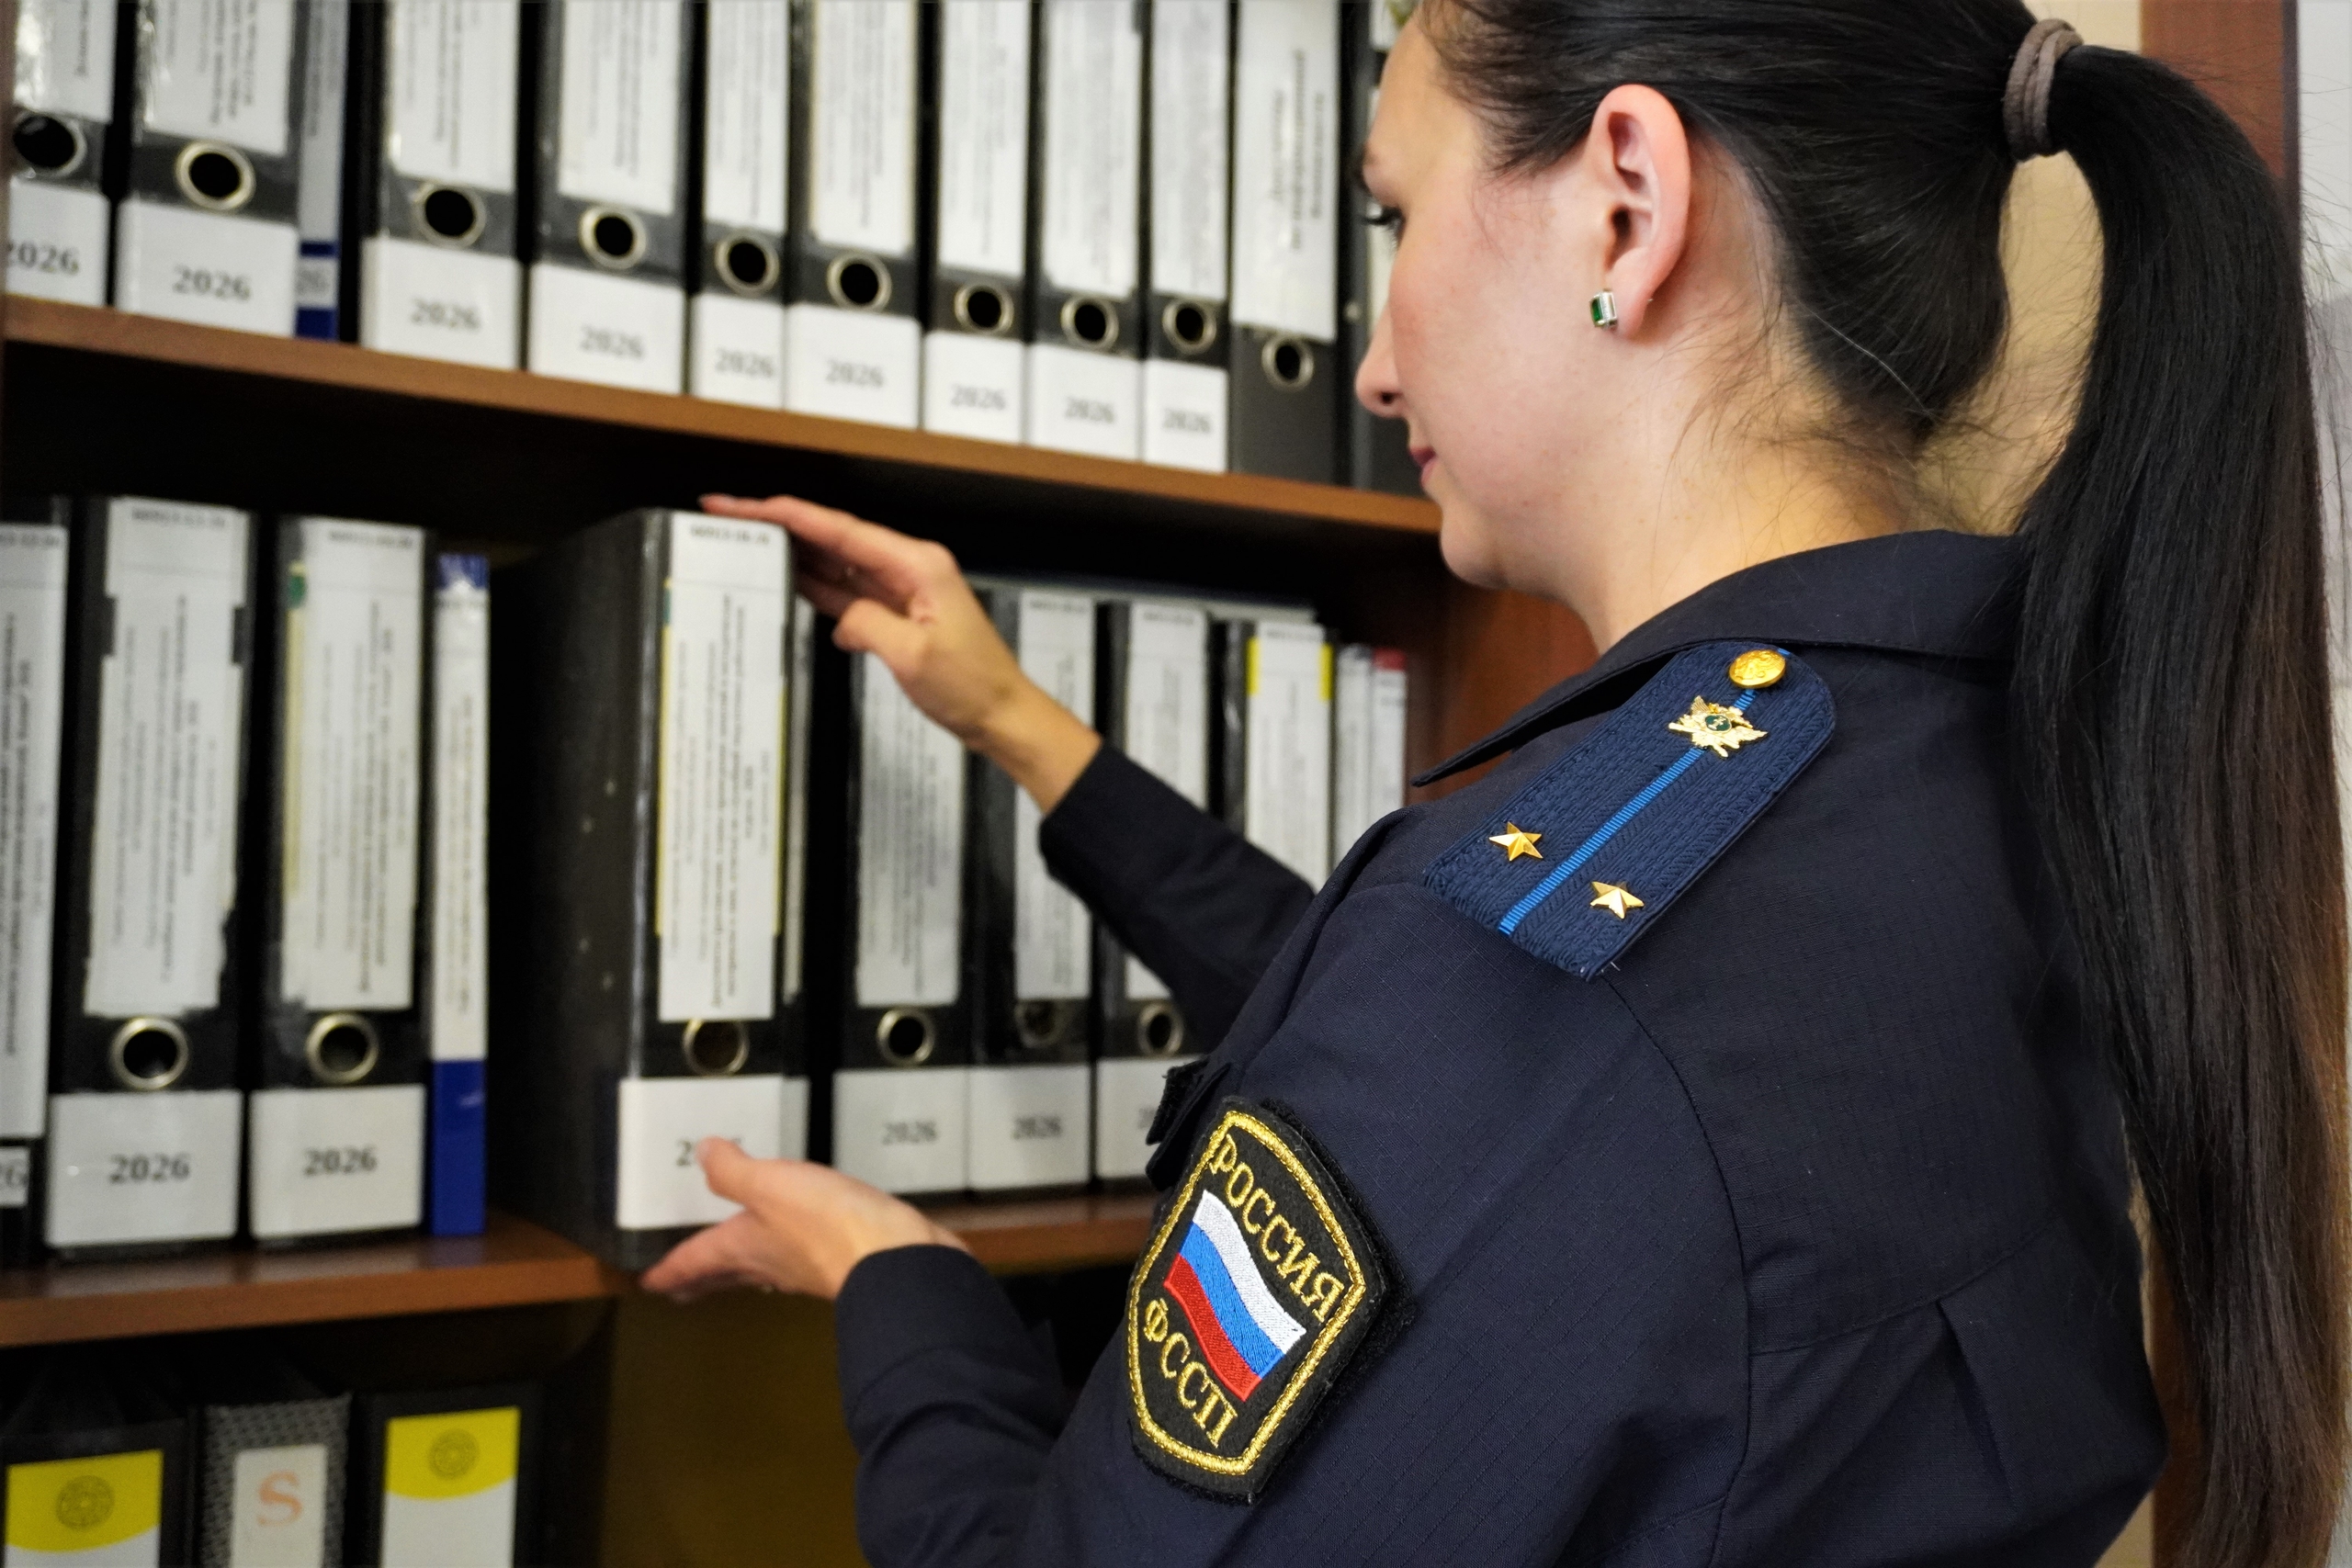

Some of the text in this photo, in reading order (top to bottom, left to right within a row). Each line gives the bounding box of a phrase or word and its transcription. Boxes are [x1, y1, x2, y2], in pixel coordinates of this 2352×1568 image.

[172, 266, 252, 302] 2026
[409, 299, 481, 332] 2026
[579, 326, 645, 360] 2026
[715, 348, 775, 379] 2026
[825, 358, 886, 389] 2026
[949, 385, 1007, 412] 2026
[107, 1153, 191, 1185] 2026
[302, 1147, 379, 1179] 2026
[1208, 1133, 1345, 1323] РОССИЯ
[1143, 1297, 1238, 1449] ФССП
